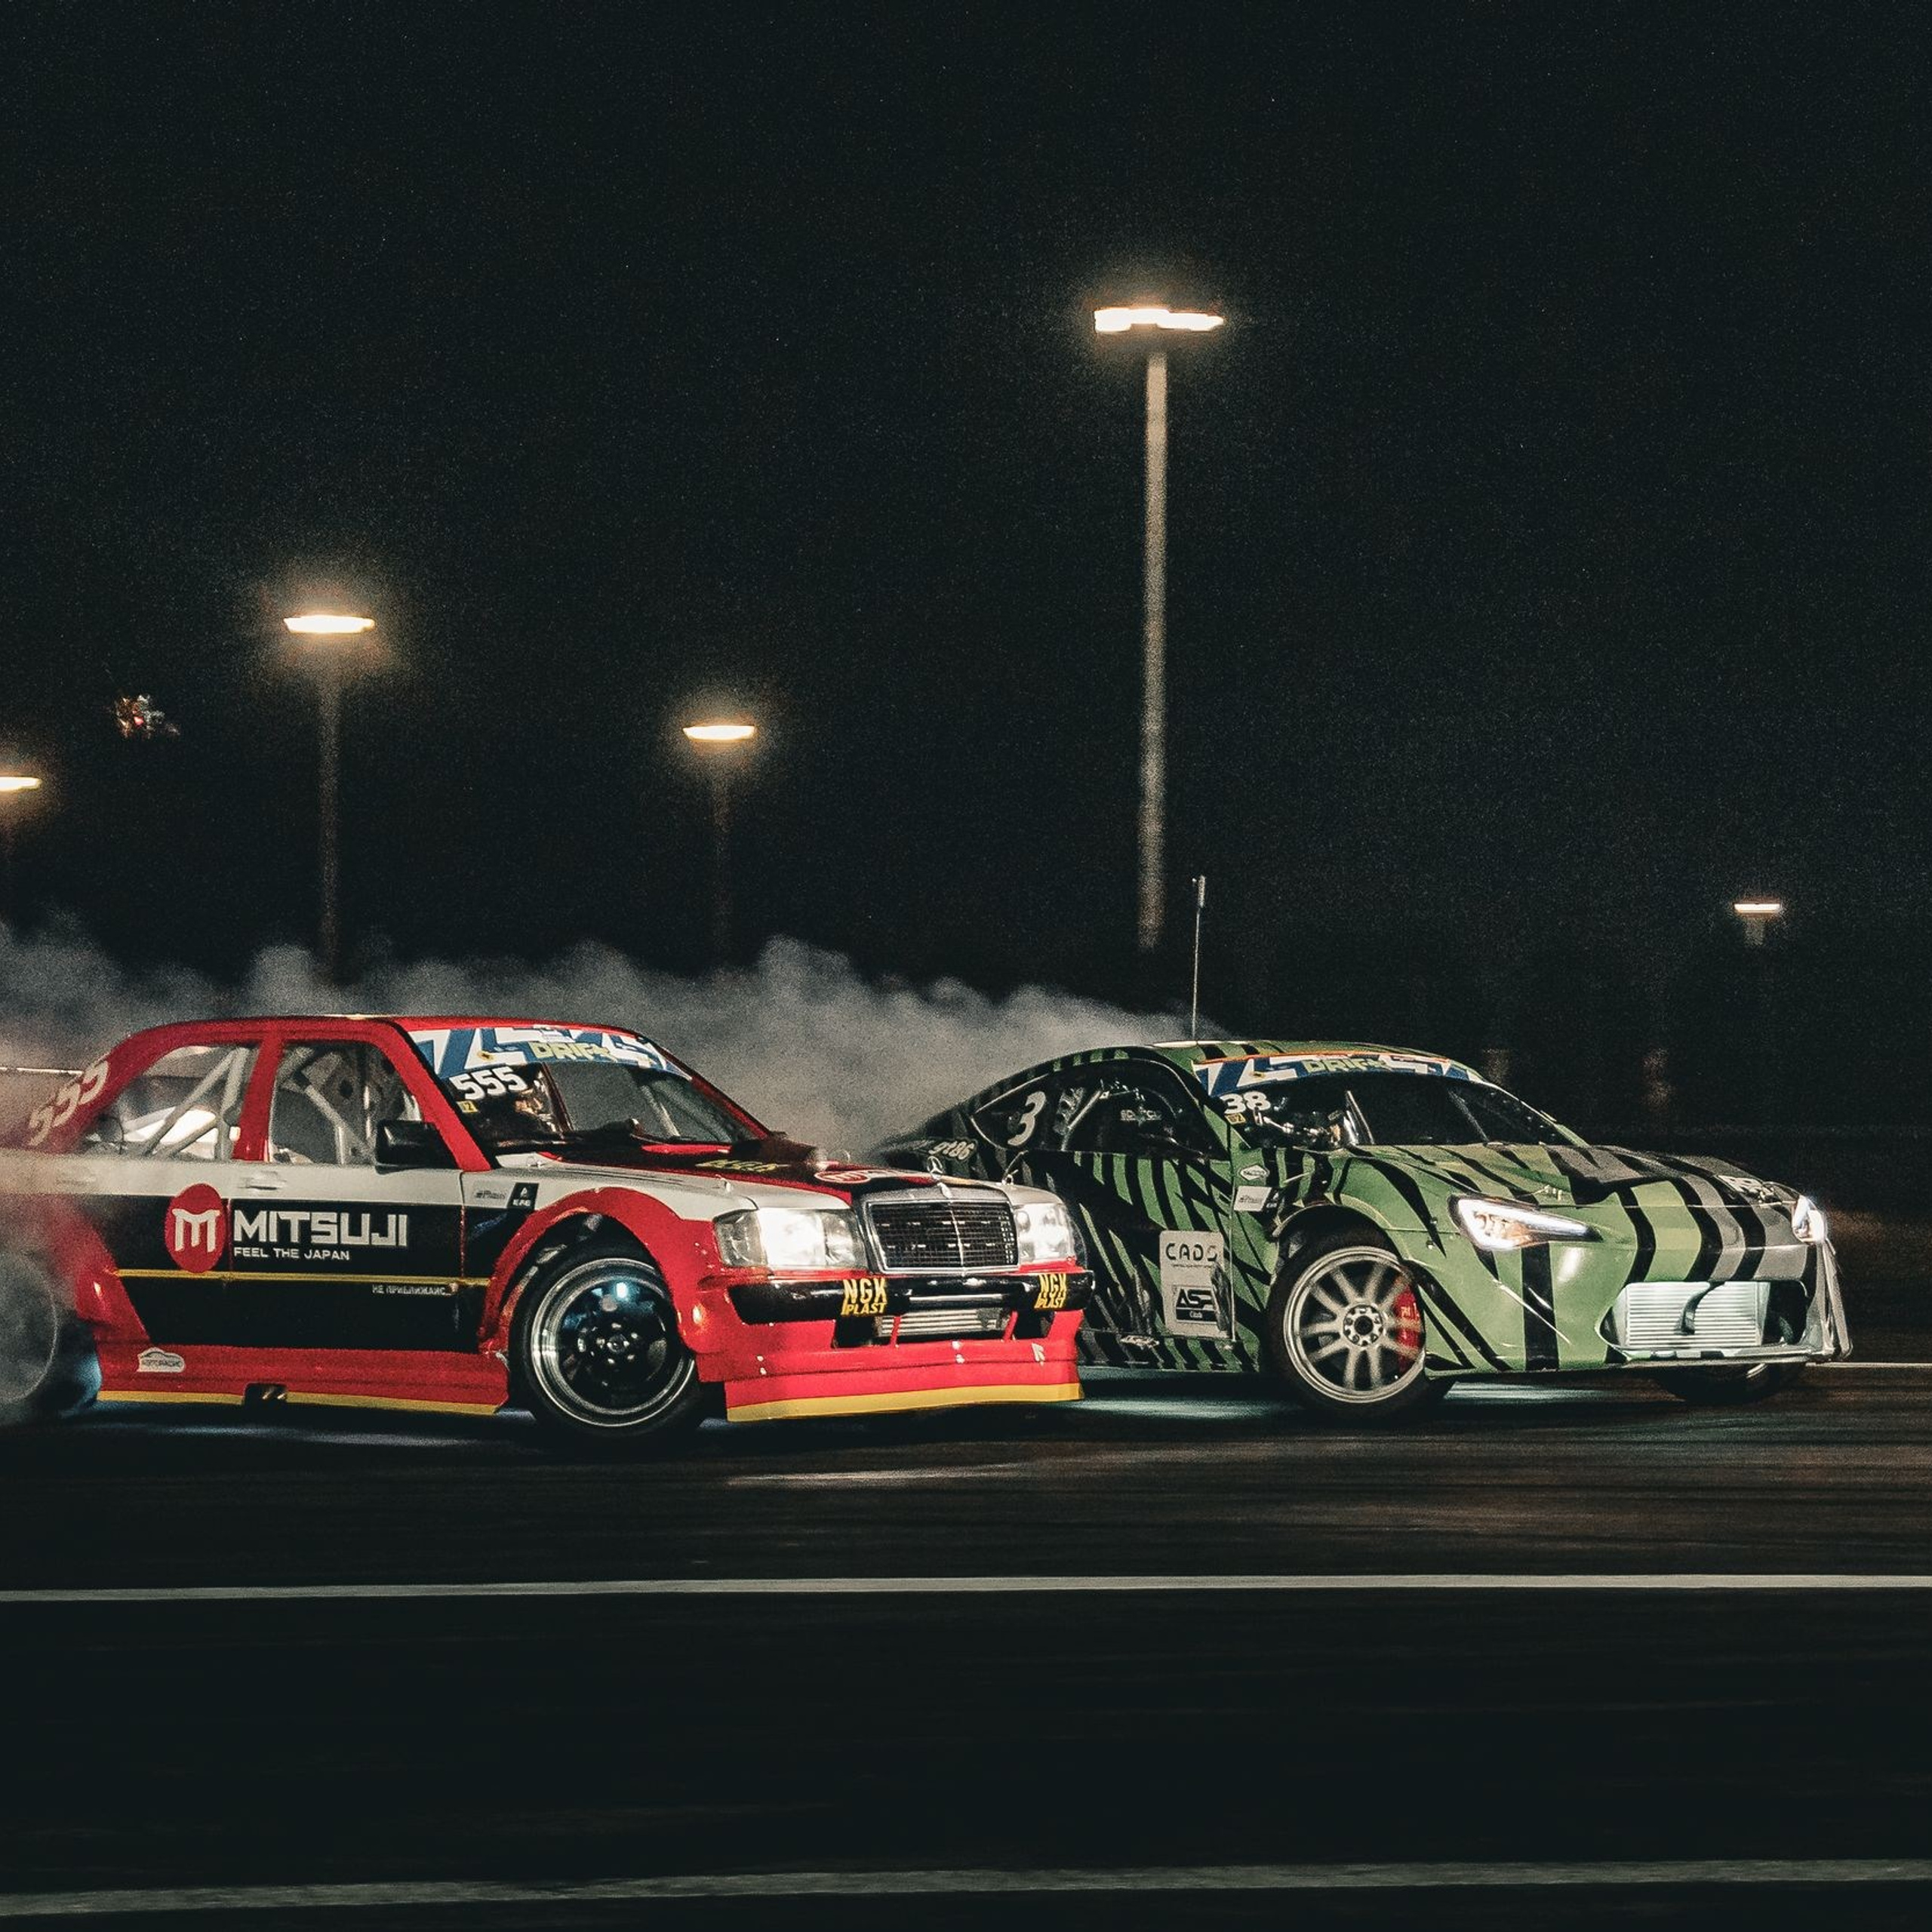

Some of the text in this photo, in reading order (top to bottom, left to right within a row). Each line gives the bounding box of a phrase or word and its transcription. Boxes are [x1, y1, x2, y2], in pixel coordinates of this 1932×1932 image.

[448, 1066, 528, 1100] 555
[1220, 1090, 1272, 1115] 38
[233, 1209, 408, 1247] MITSUJI
[233, 1247, 350, 1261] FEEL THE JAPAN
